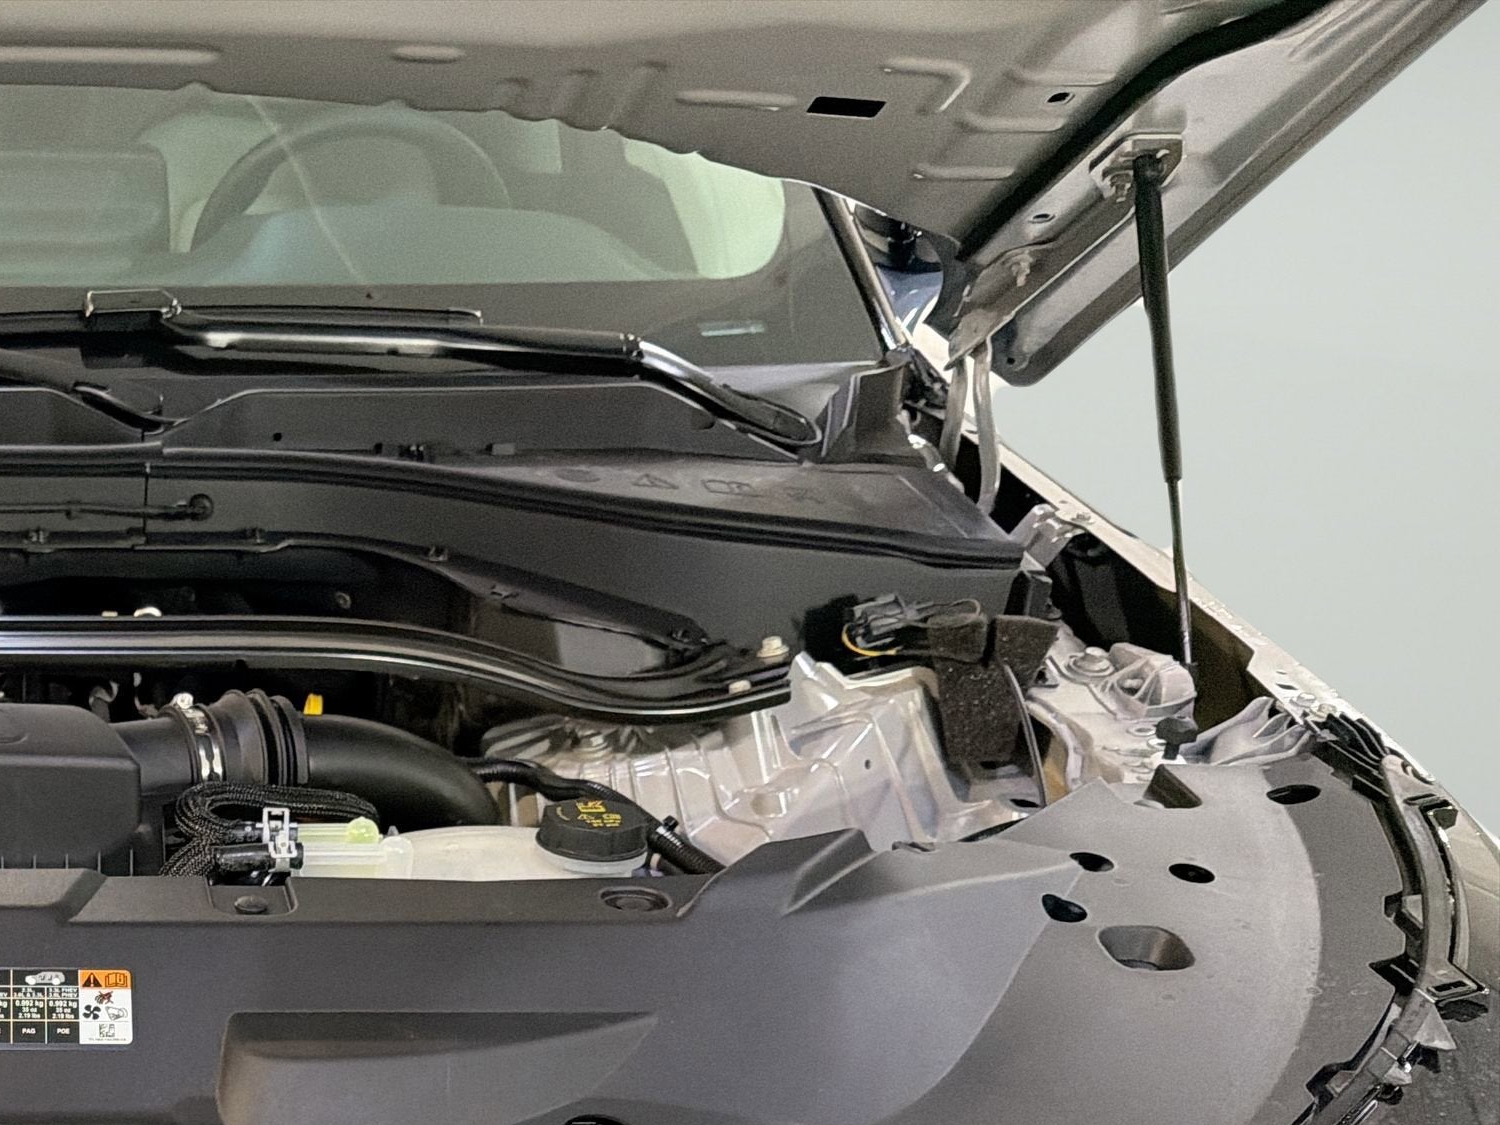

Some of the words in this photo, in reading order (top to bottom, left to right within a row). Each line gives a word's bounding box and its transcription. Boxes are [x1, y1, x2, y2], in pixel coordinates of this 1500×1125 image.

[34, 999, 44, 1008] kg
[68, 1000, 78, 1009] kg
[21, 1027, 37, 1035] PAG
[56, 1027, 71, 1035] POE
